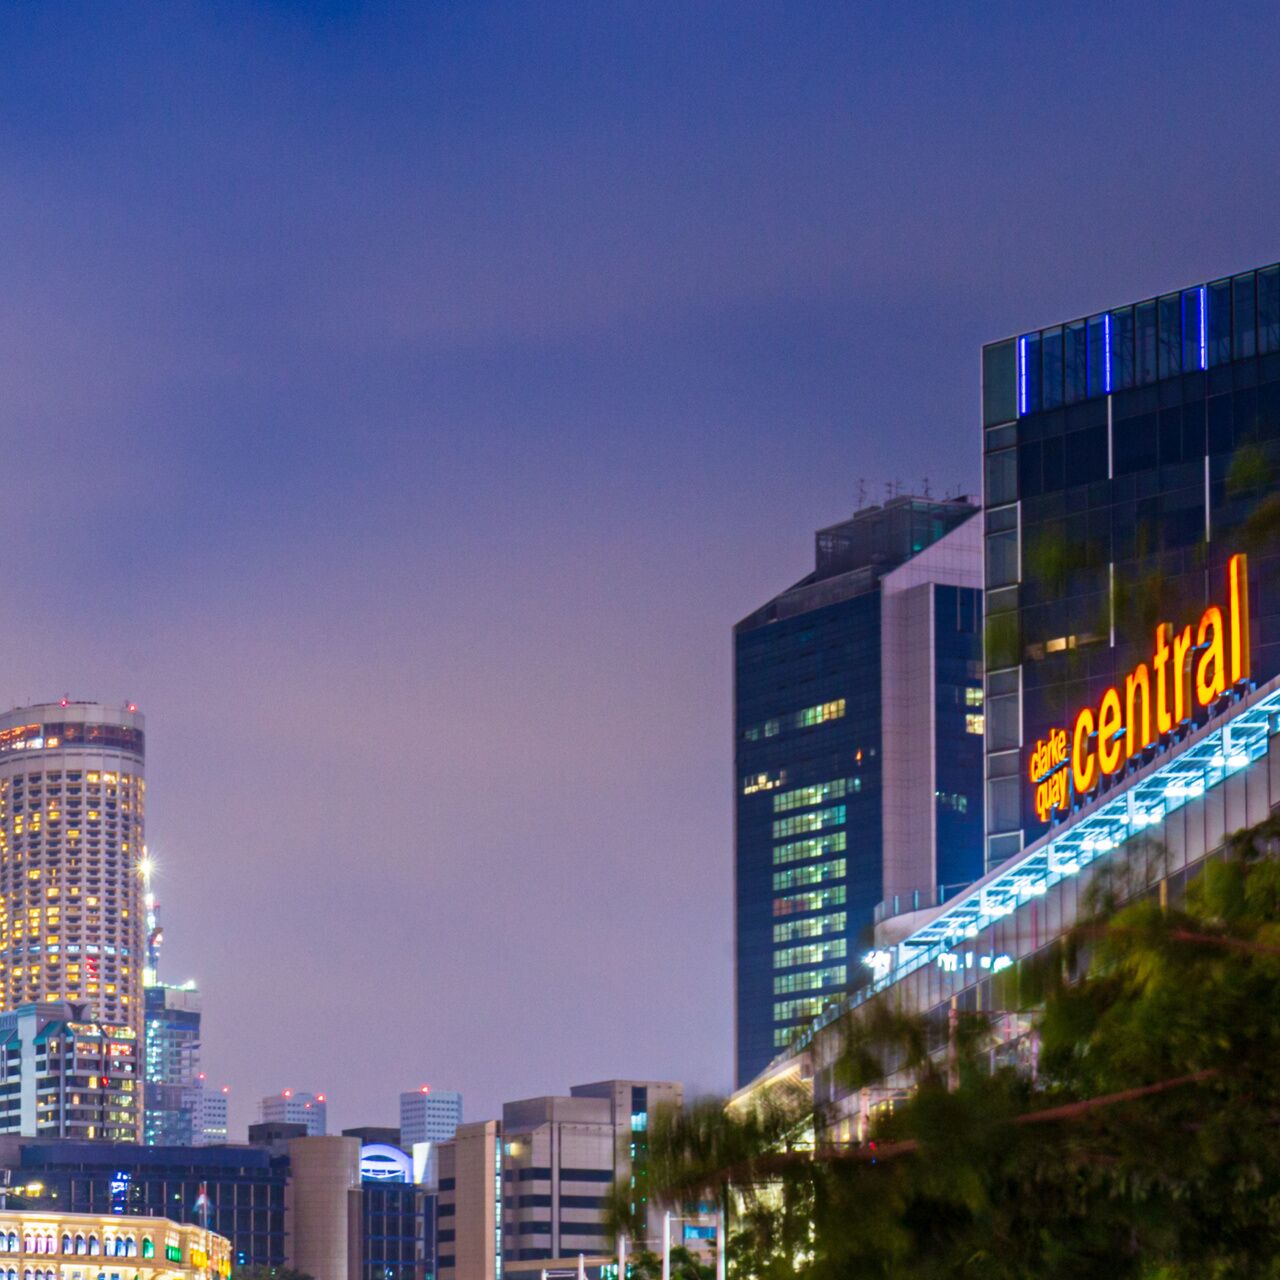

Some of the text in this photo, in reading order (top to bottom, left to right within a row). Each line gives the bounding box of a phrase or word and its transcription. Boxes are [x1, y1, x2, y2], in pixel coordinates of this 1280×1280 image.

[1071, 552, 1248, 793] central
[1030, 728, 1067, 783] clarke
[1036, 767, 1069, 823] quay
